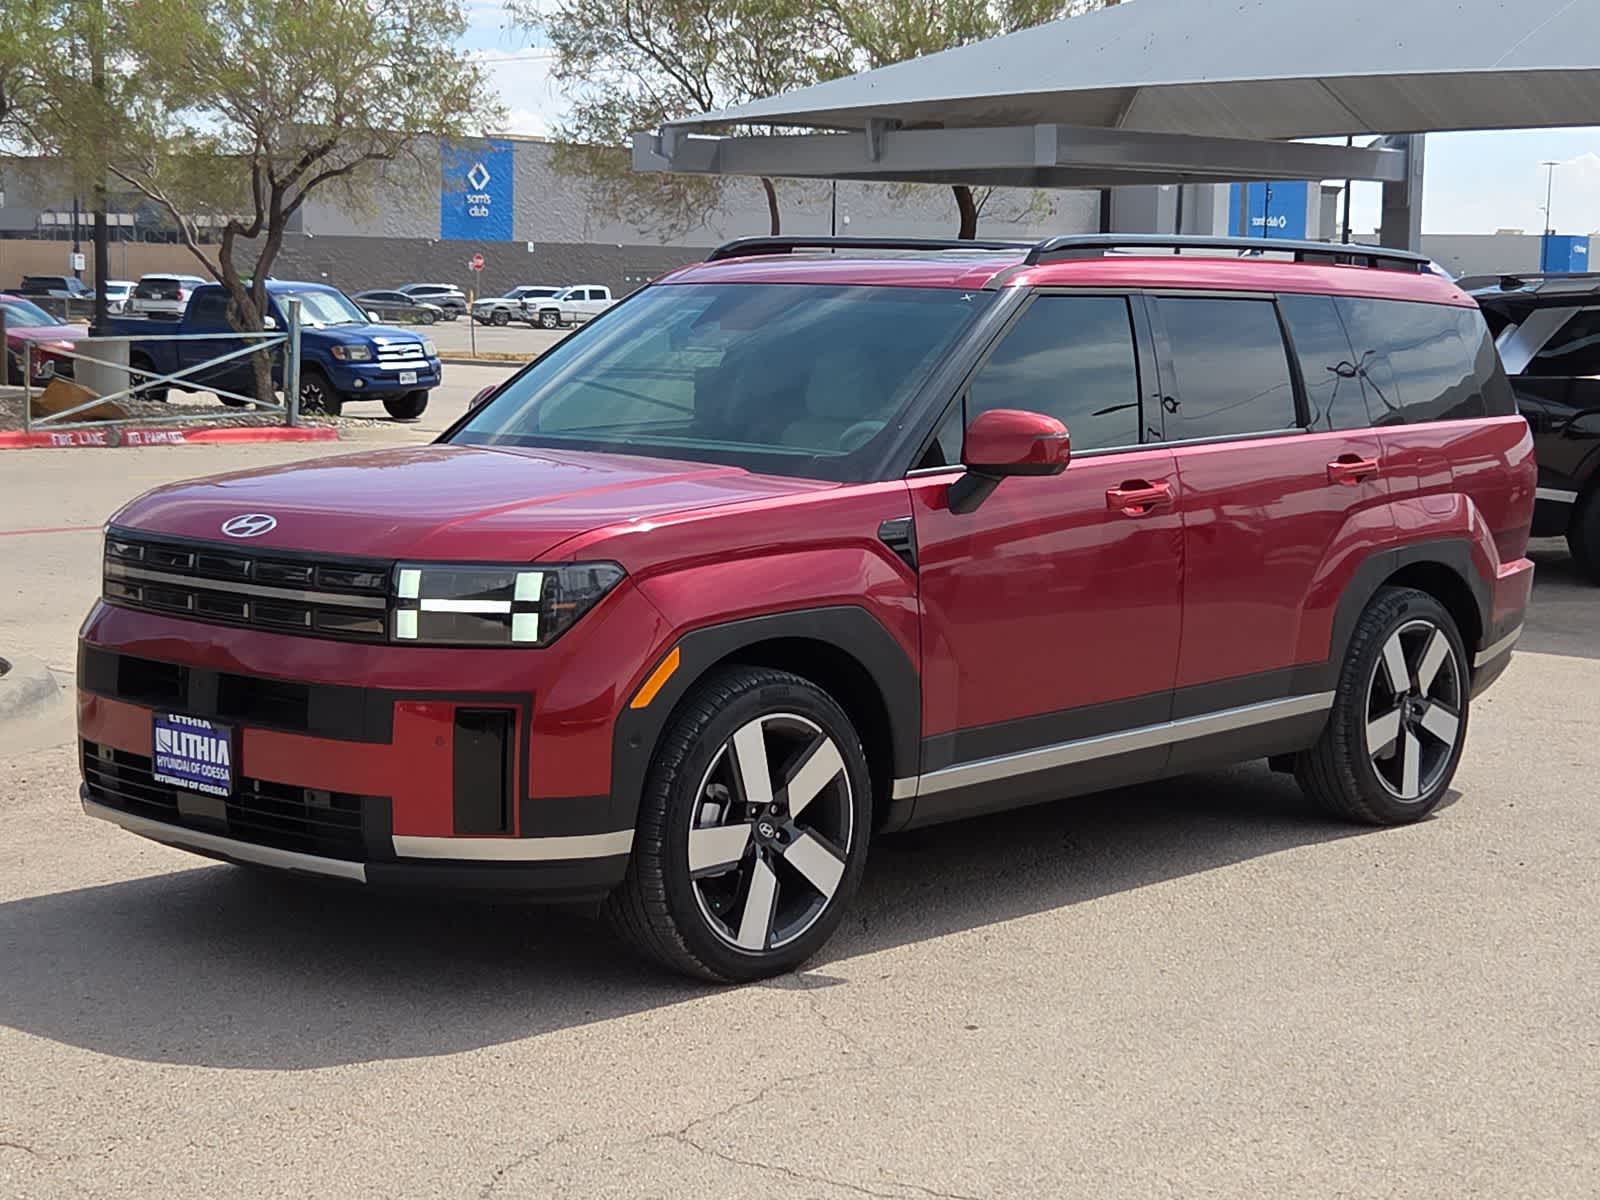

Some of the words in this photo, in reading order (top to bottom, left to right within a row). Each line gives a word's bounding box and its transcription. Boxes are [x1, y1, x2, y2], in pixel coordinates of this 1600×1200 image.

[468, 205, 489, 217] club
[51, 432, 77, 446] FIRE
[80, 431, 108, 446] LANE
[172, 730, 230, 766] LITHIA
[156, 755, 190, 773] HYUNDAI
[190, 762, 201, 774] OF
[201, 764, 230, 781] ODESSA
